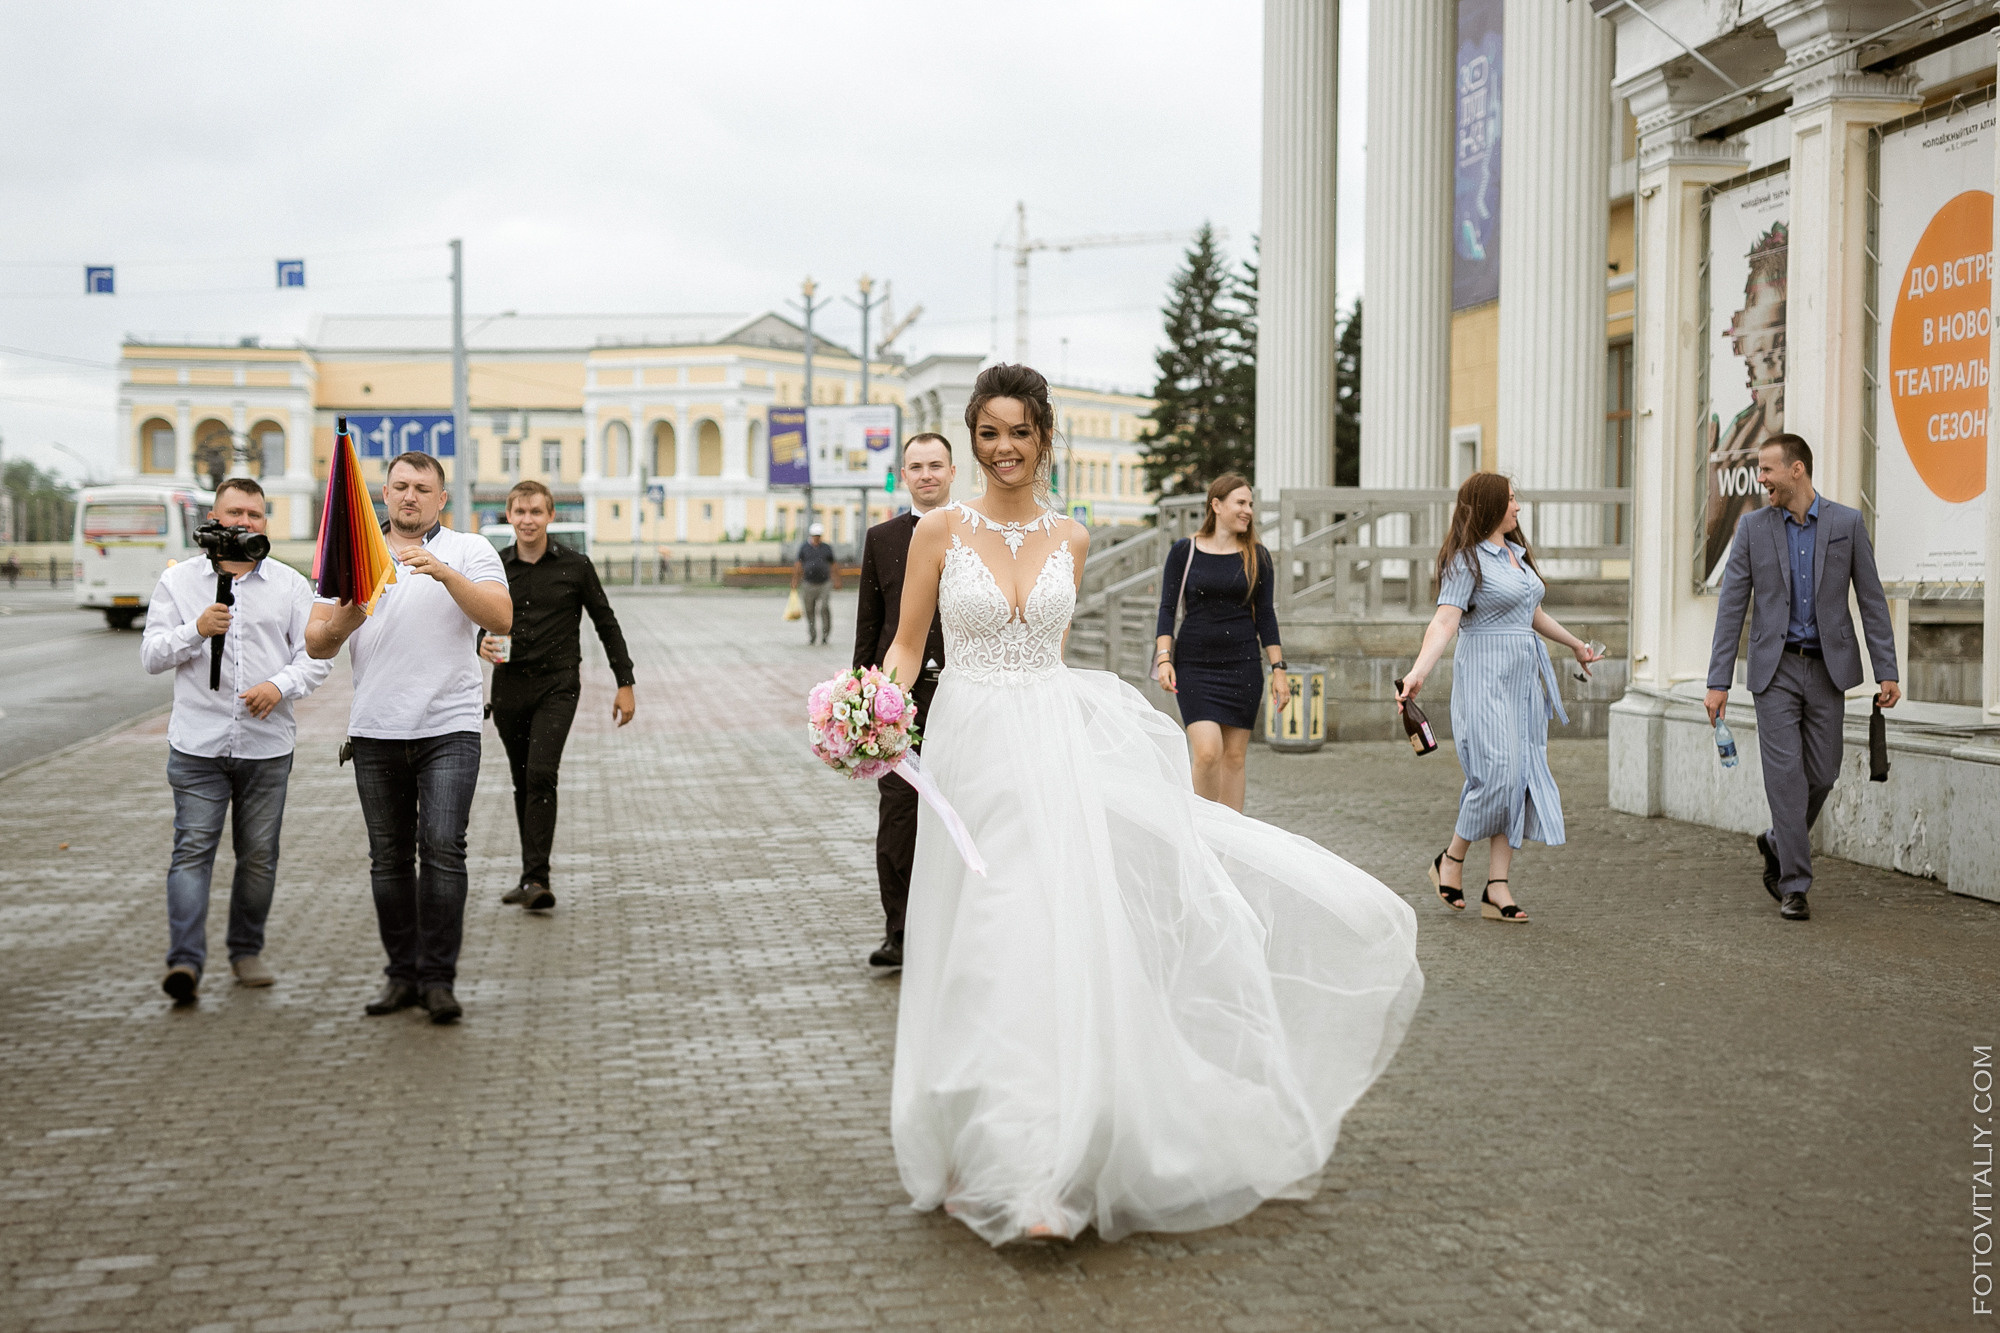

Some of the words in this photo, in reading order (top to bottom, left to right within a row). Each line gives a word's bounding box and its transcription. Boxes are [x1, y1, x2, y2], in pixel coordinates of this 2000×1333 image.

[1908, 264, 1938, 300] ДО
[1943, 251, 1993, 290] ВСТРЕ
[1923, 317, 1934, 346] В
[1938, 307, 1991, 343] НОВО
[1895, 358, 1989, 397] ТЕАТРАЛЬ
[1927, 408, 1988, 442] СЕЗОН
